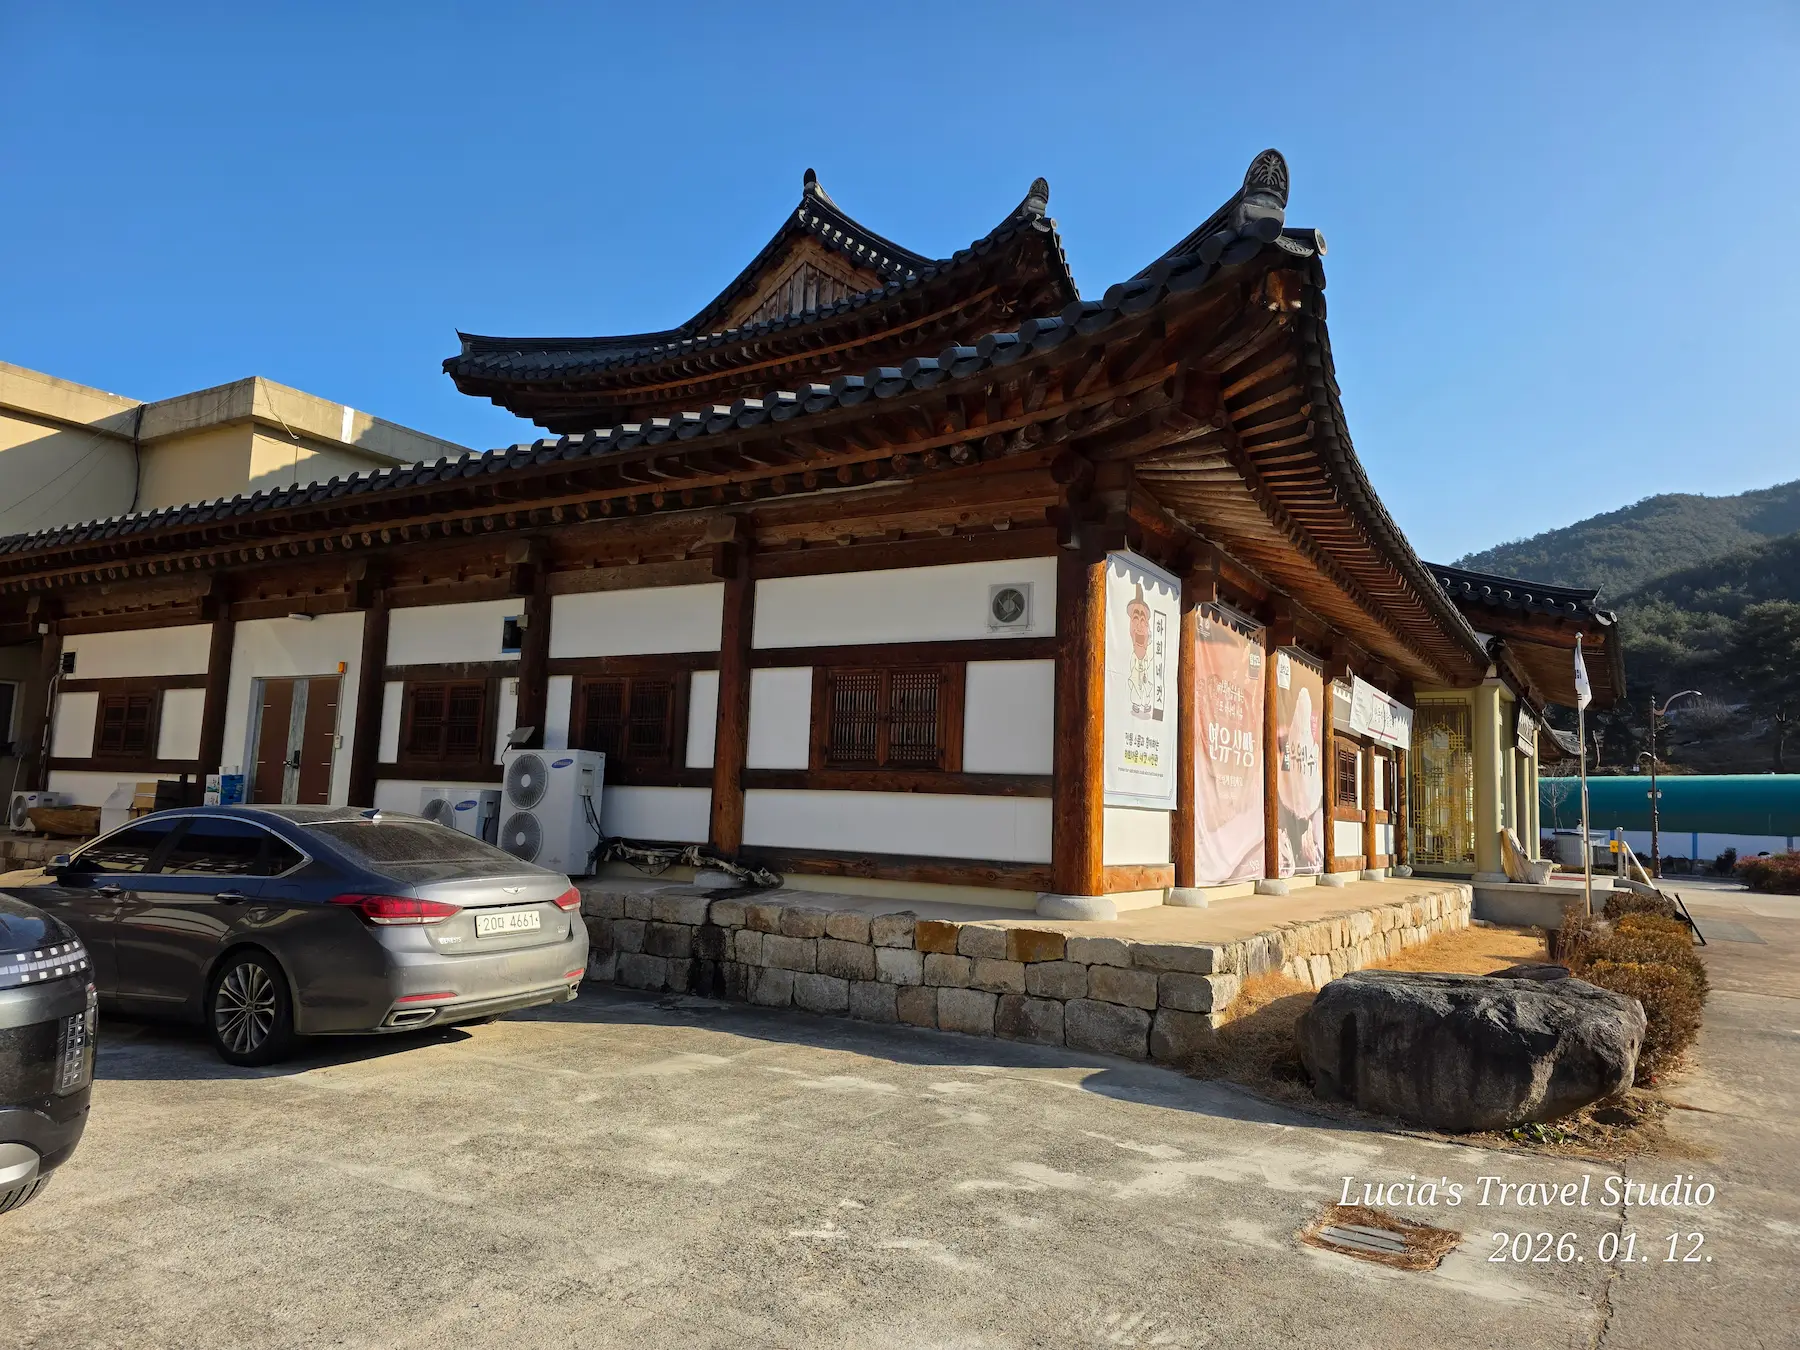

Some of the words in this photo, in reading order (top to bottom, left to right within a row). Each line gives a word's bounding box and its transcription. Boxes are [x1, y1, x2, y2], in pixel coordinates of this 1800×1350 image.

[1156, 618, 1164, 703] 하회네컷
[1208, 722, 1256, 768] 연유식빵
[510, 913, 534, 928] 4661
